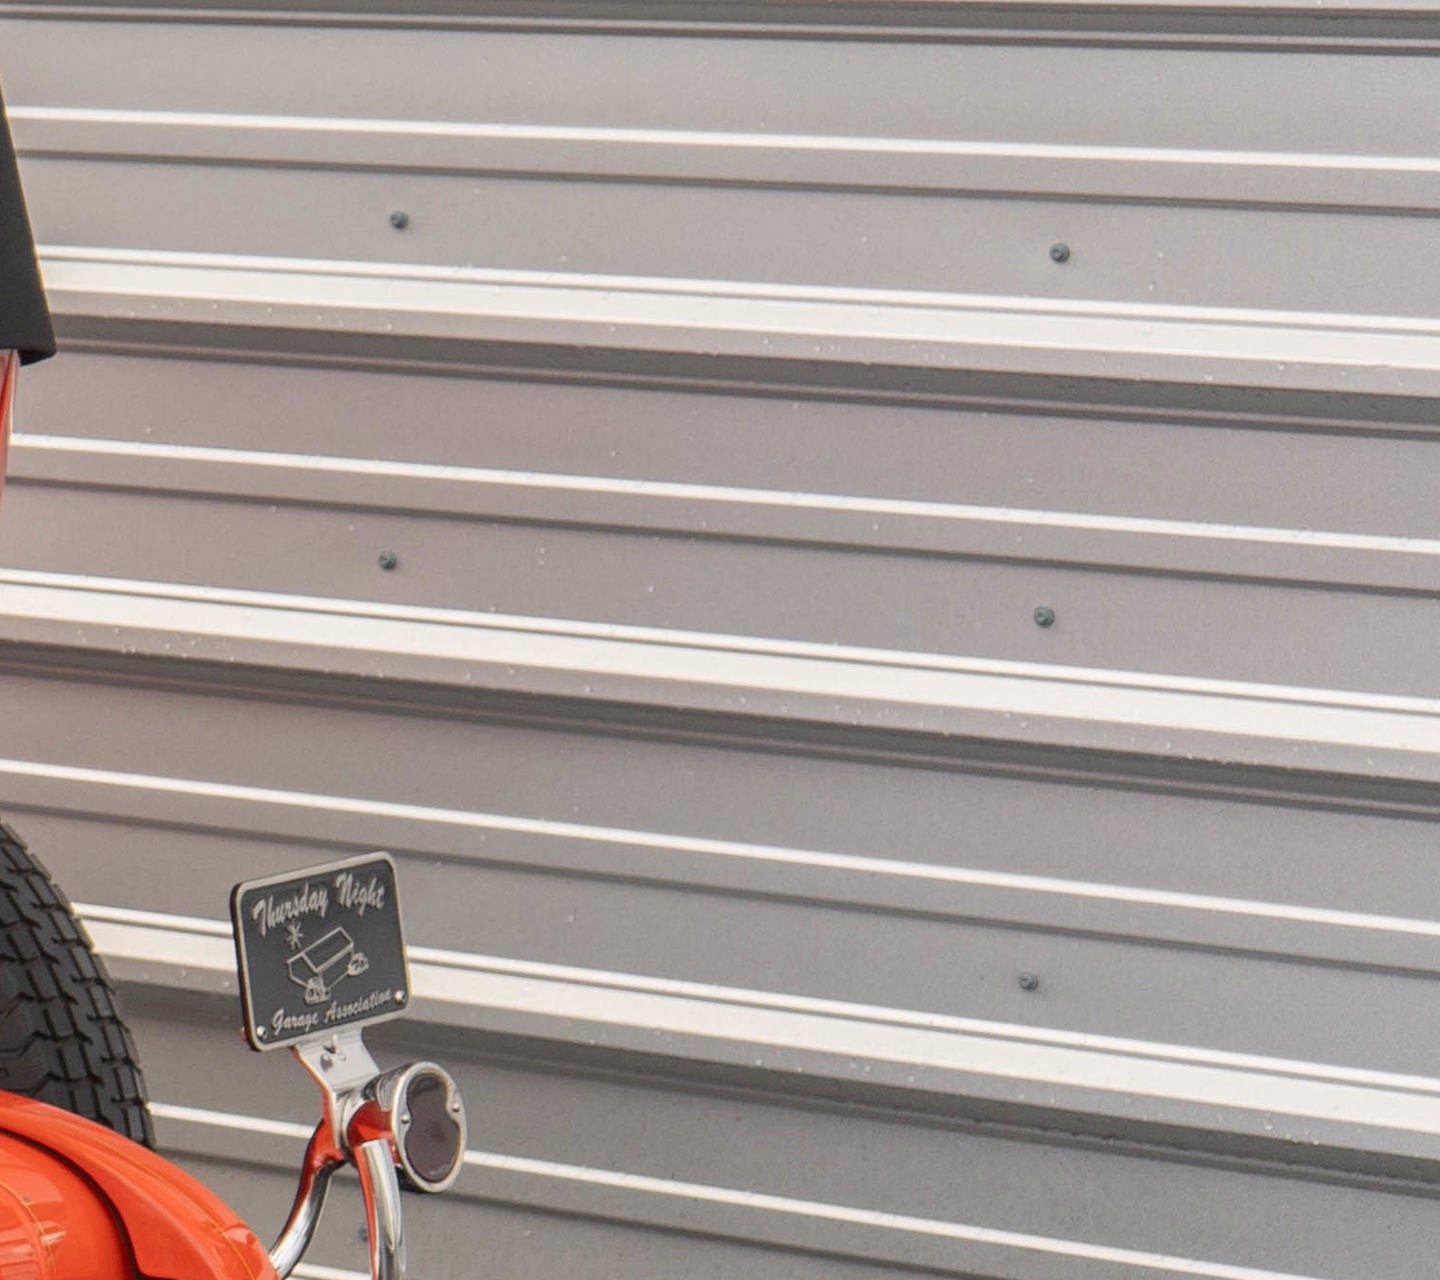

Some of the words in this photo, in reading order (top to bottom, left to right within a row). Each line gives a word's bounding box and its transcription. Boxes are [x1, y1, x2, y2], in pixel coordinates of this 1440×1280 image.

[252, 884, 329, 937] Thursday
[335, 872, 386, 917] Night
[271, 1006, 320, 1037] Garage
[323, 988, 393, 1024] Association
